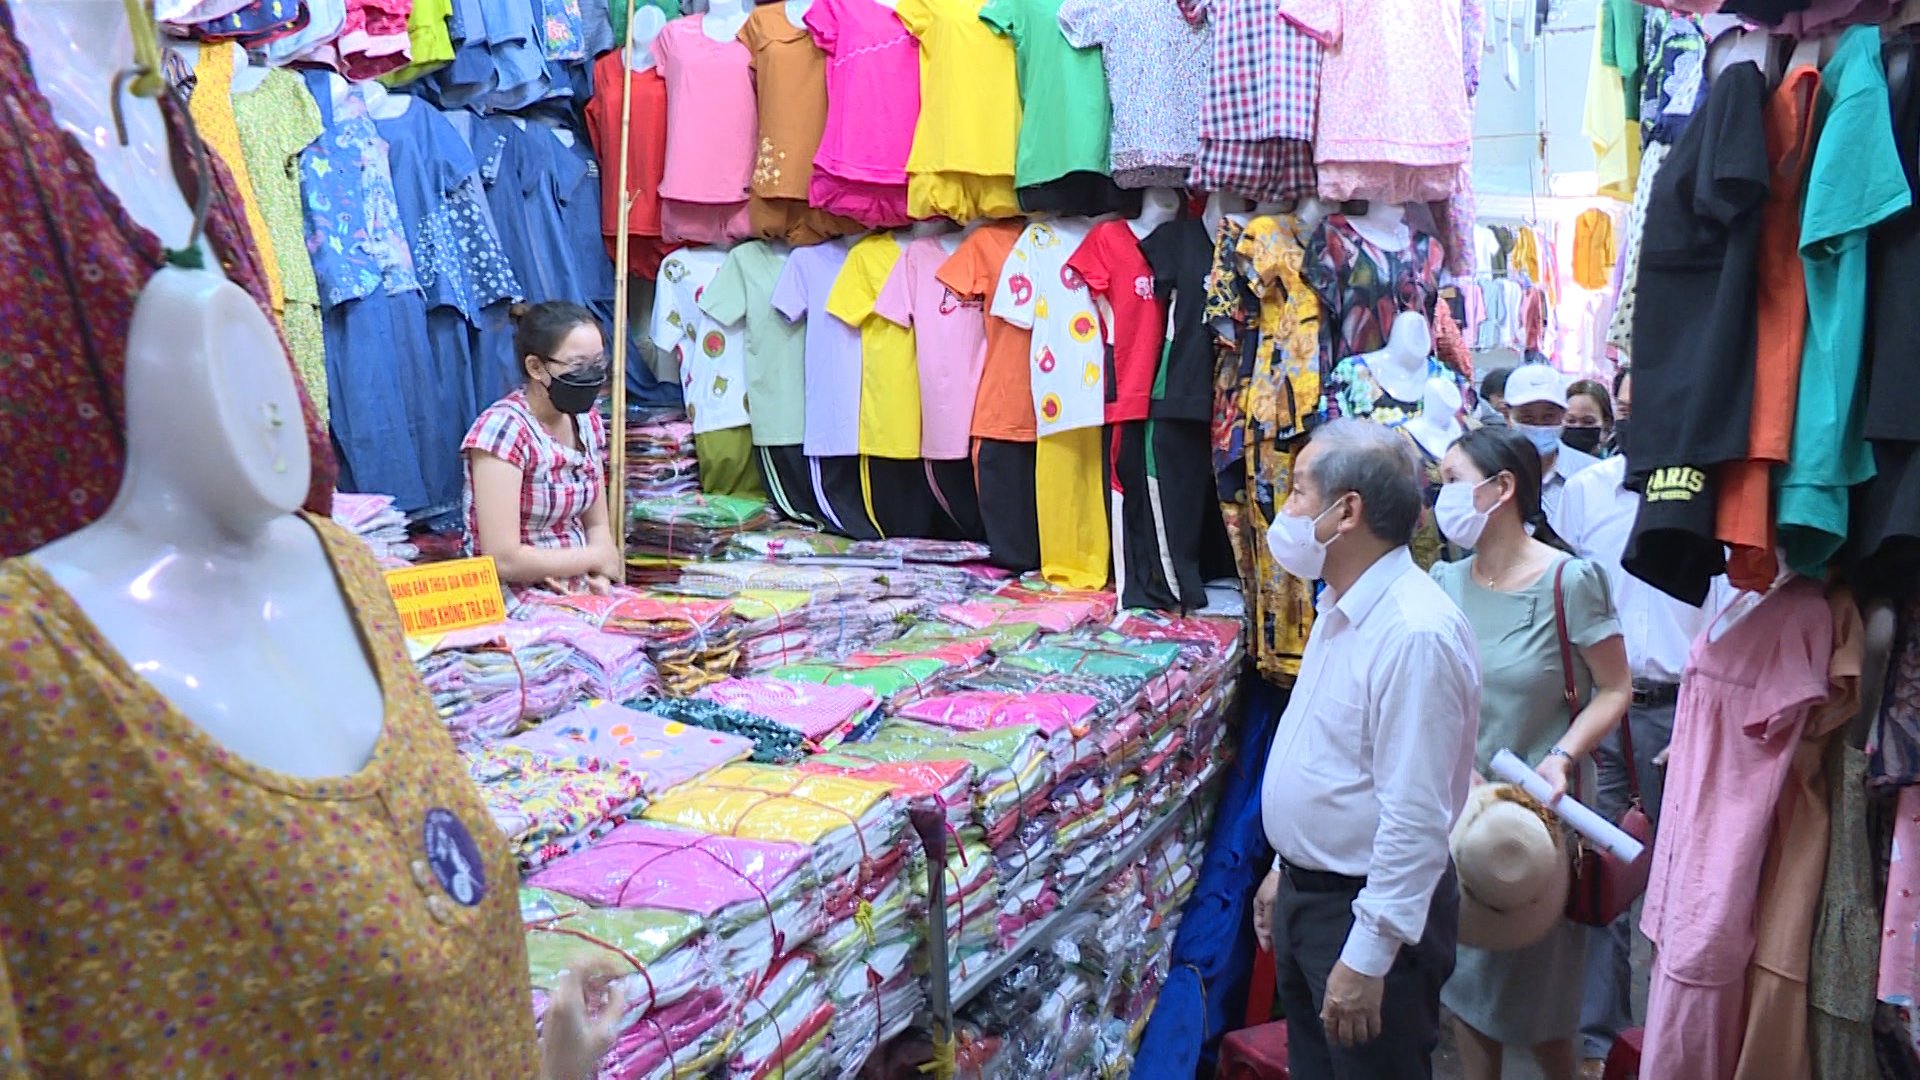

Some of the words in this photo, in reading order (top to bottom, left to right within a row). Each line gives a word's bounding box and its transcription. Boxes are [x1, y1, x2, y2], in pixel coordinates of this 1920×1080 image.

[429, 576, 448, 593] THEO
[437, 600, 467, 625] KHÔNG
[466, 595, 482, 619] TRẢ
